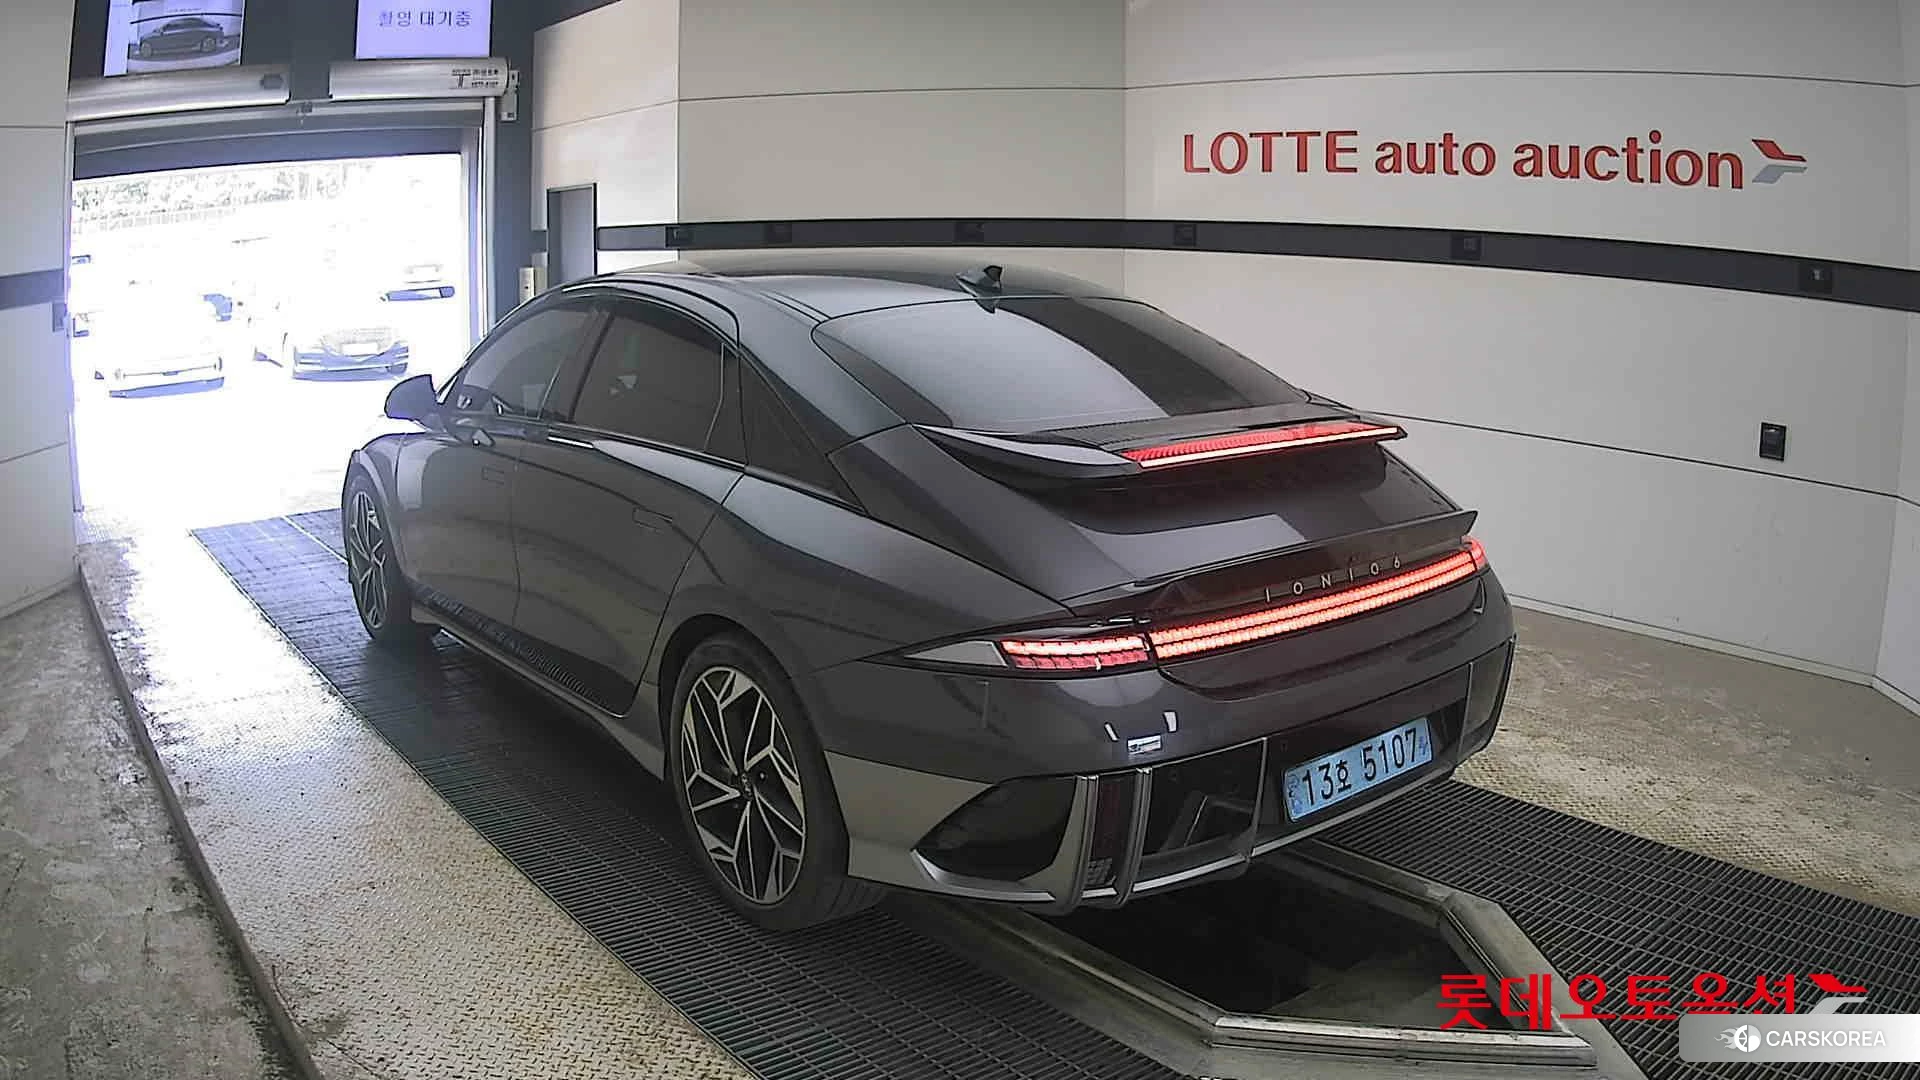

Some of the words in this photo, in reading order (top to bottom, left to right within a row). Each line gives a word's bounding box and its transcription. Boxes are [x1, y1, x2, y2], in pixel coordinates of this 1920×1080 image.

[419, 11, 472, 27] 대기중
[1183, 130, 1358, 174] LOTTE
[1375, 132, 1497, 177] auto
[1511, 130, 1744, 189] auction
[1302, 759, 1352, 806] 13호
[1360, 727, 1417, 782] 5107
